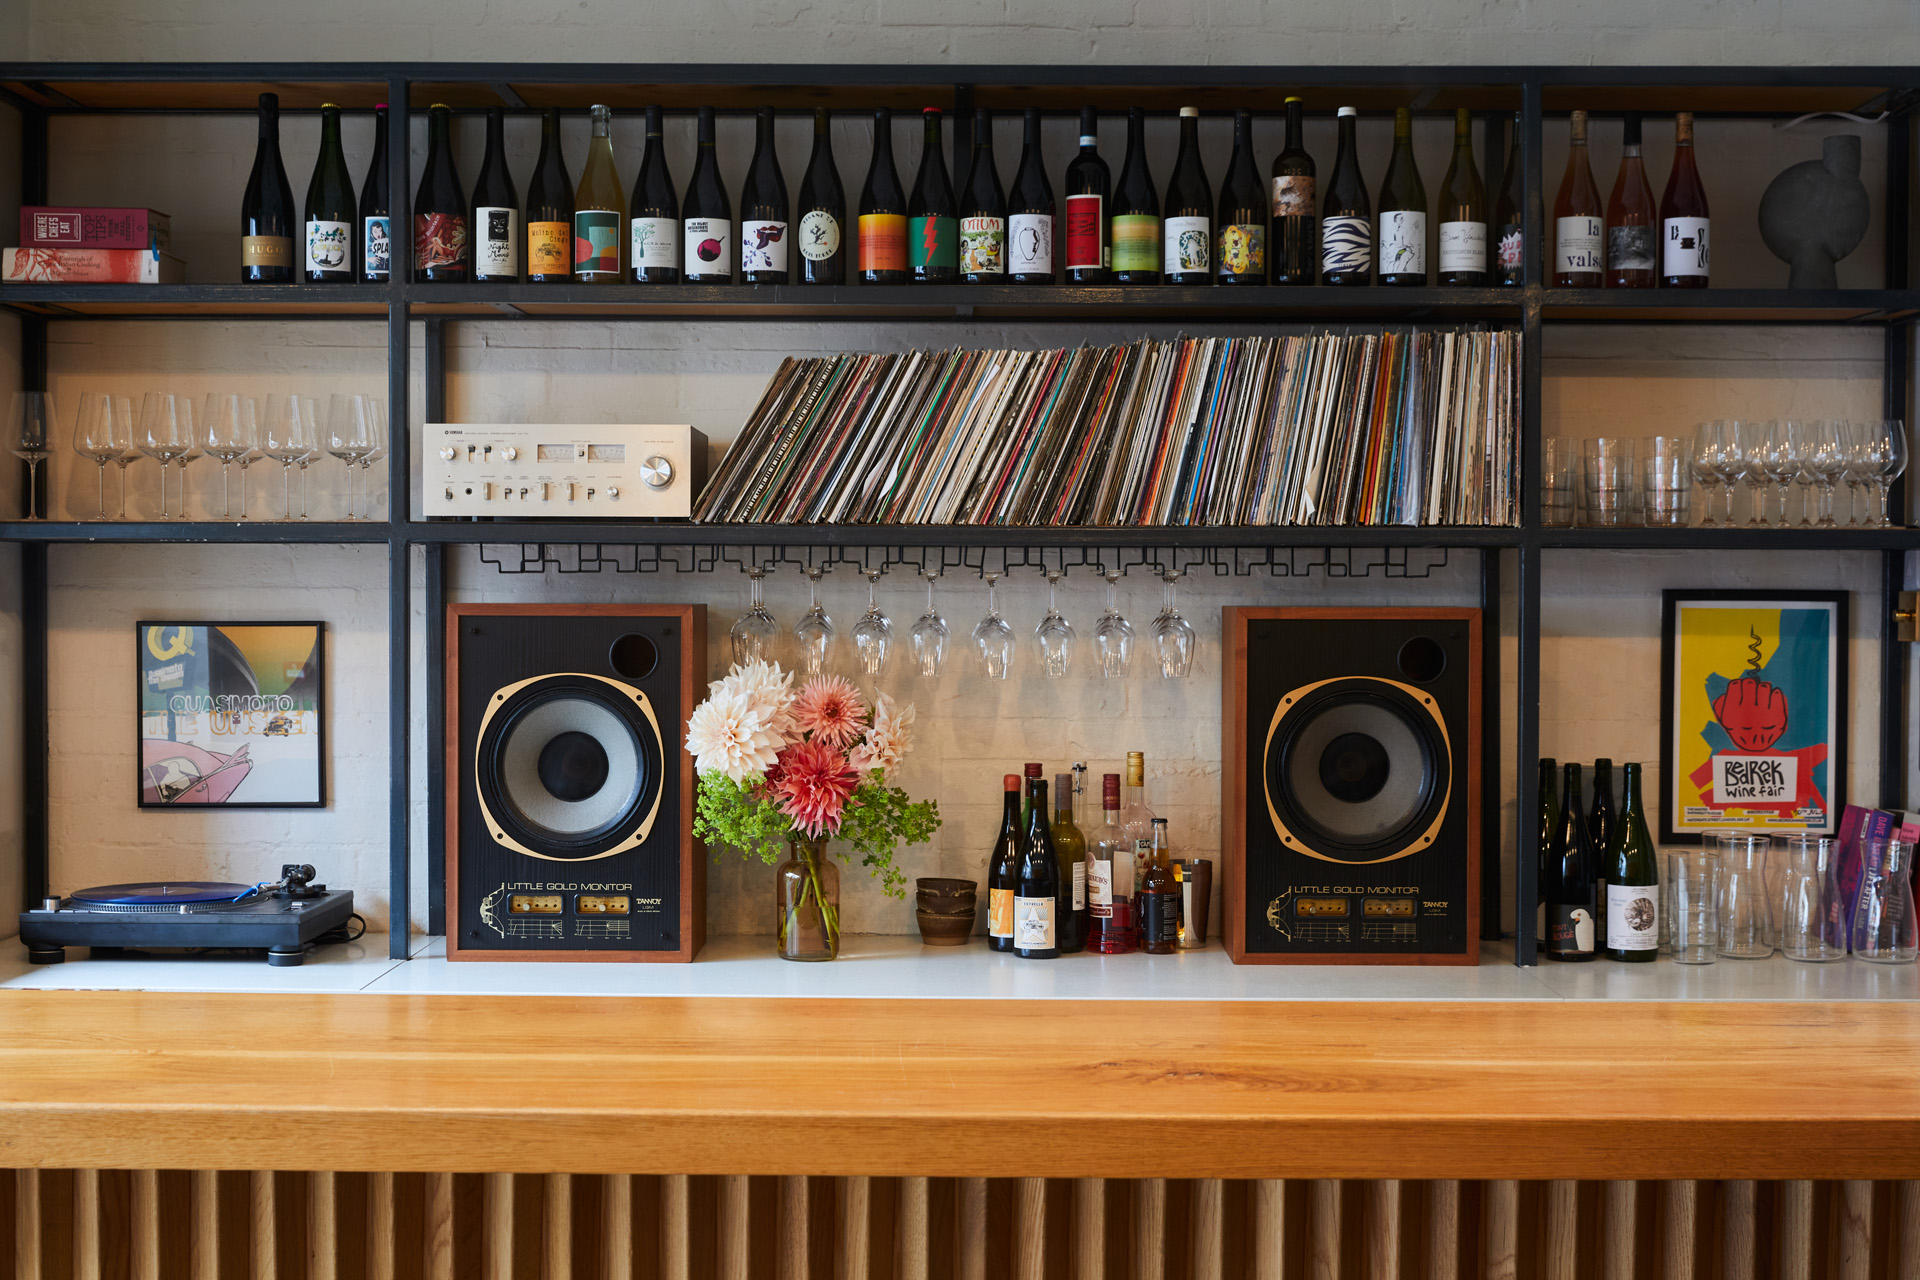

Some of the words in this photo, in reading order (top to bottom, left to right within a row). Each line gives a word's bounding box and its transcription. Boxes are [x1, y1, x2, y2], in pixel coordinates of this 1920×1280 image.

[37, 215, 48, 239] WHERE
[48, 217, 59, 238] CHEFS
[60, 221, 70, 234] EAT
[84, 215, 95, 241] TOP
[95, 215, 106, 241] TIPS
[962, 218, 999, 231] OTIUM
[1587, 219, 1599, 236] la
[249, 246, 283, 254] HUGO
[488, 243, 510, 252] Night
[77, 261, 101, 269] Cooking
[147, 625, 196, 661] Q
[170, 694, 295, 714] QUASIMOTO
[209, 710, 319, 737] UNSEEN
[1726, 787, 1757, 798] wine
[1759, 785, 1785, 798] fair
[1876, 815, 1888, 836] DAVE
[507, 882, 544, 890] LITTLE
[546, 882, 578, 890] GOLD
[580, 883, 632, 891] MONITOR
[1294, 886, 1330, 894] LITTLE
[1333, 886, 1364, 894] GOLD
[1367, 886, 1420, 894] MONITOR
[1860, 885, 1873, 910] AFTER
[1553, 932, 1574, 941] ROUGE
